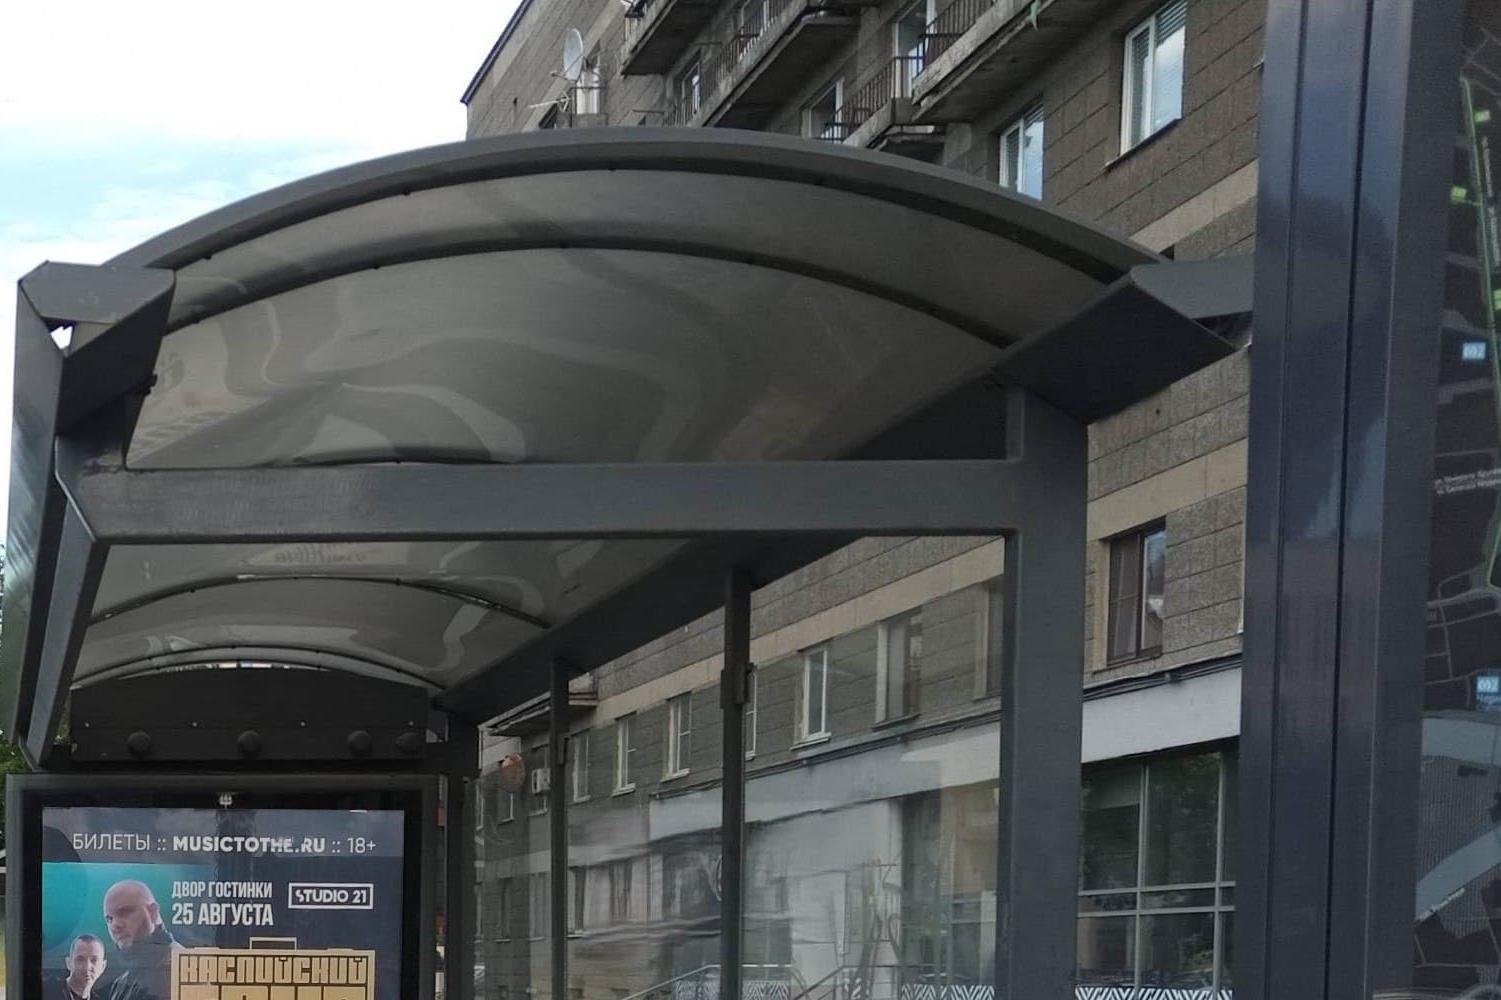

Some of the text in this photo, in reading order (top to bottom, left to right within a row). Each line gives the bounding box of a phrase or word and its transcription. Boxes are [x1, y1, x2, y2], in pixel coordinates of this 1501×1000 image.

[72, 832, 151, 851] БИЛЕТЫ
[172, 835, 326, 854] MUSICTOTHE.RU
[346, 837, 377, 855] 18+
[171, 880, 273, 899] ДВОР ГОСТИНКИ
[294, 888, 367, 905] STUDIO 21
[171, 902, 275, 927] 25 АВГУСТА
[179, 955, 367, 985] КАСПИЙСКИЙ
